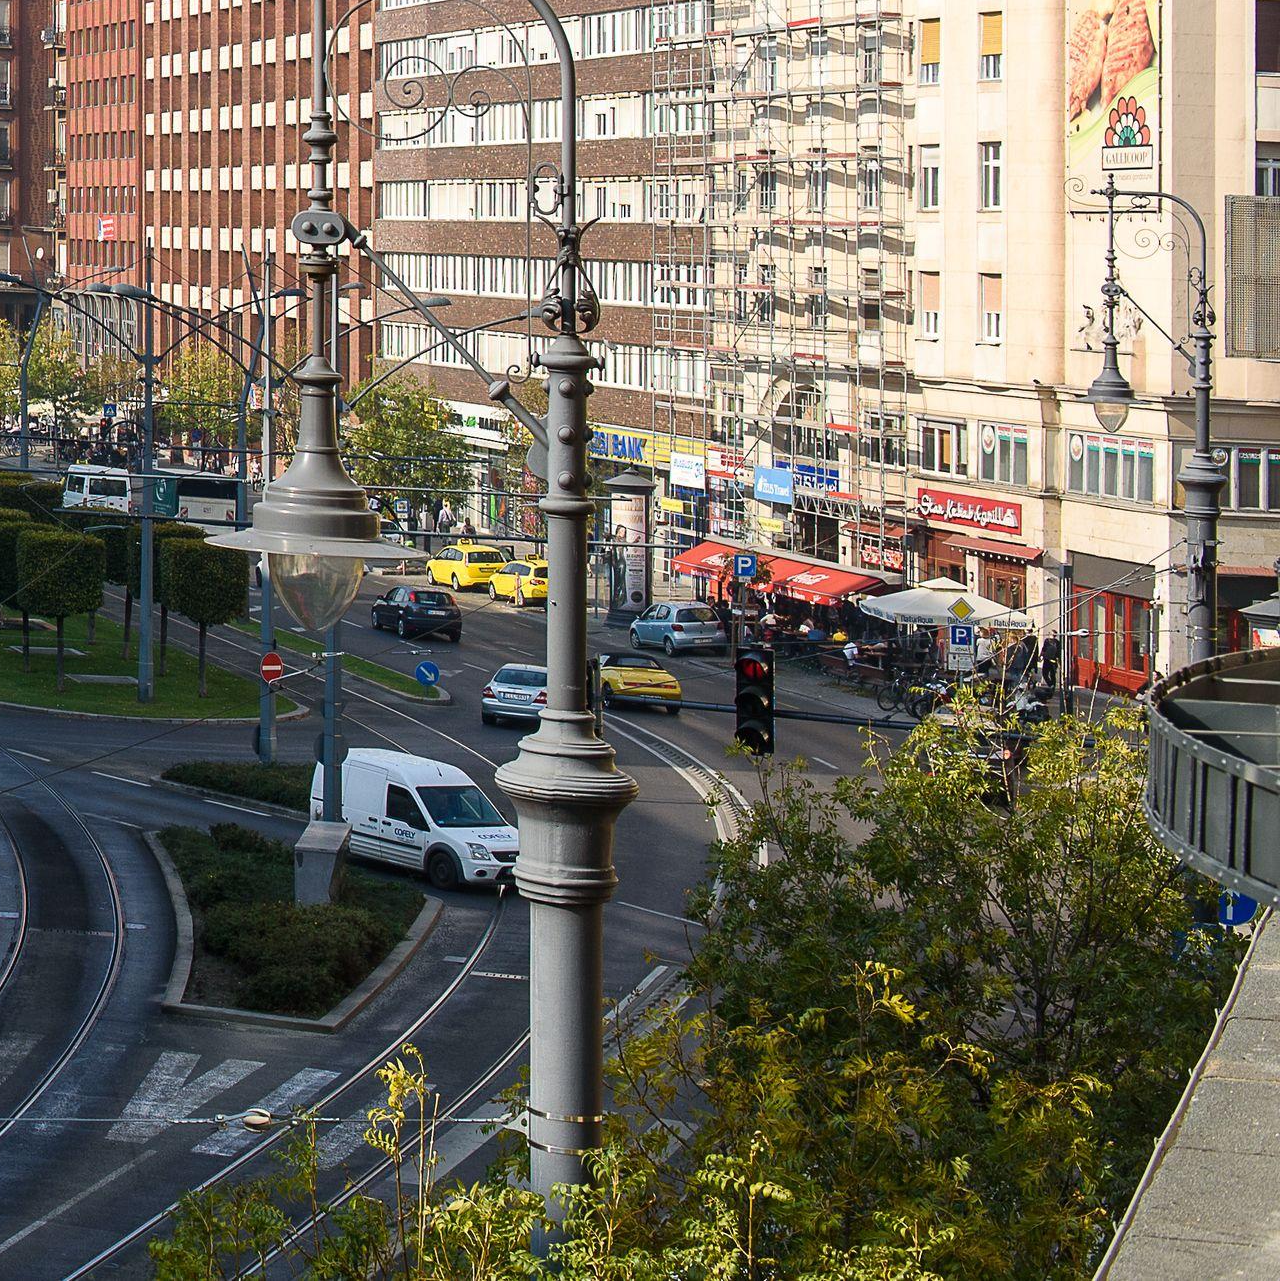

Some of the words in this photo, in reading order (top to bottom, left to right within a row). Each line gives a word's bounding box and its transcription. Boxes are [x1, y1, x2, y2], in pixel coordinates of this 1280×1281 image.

[1106, 151, 1147, 165] GALLICOOP
[612, 434, 644, 461] BANK
[738, 556, 752, 574] P
[900, 614, 934, 624] NaturAqua
[955, 628, 967, 643] P
[394, 827, 416, 839] COFELY
